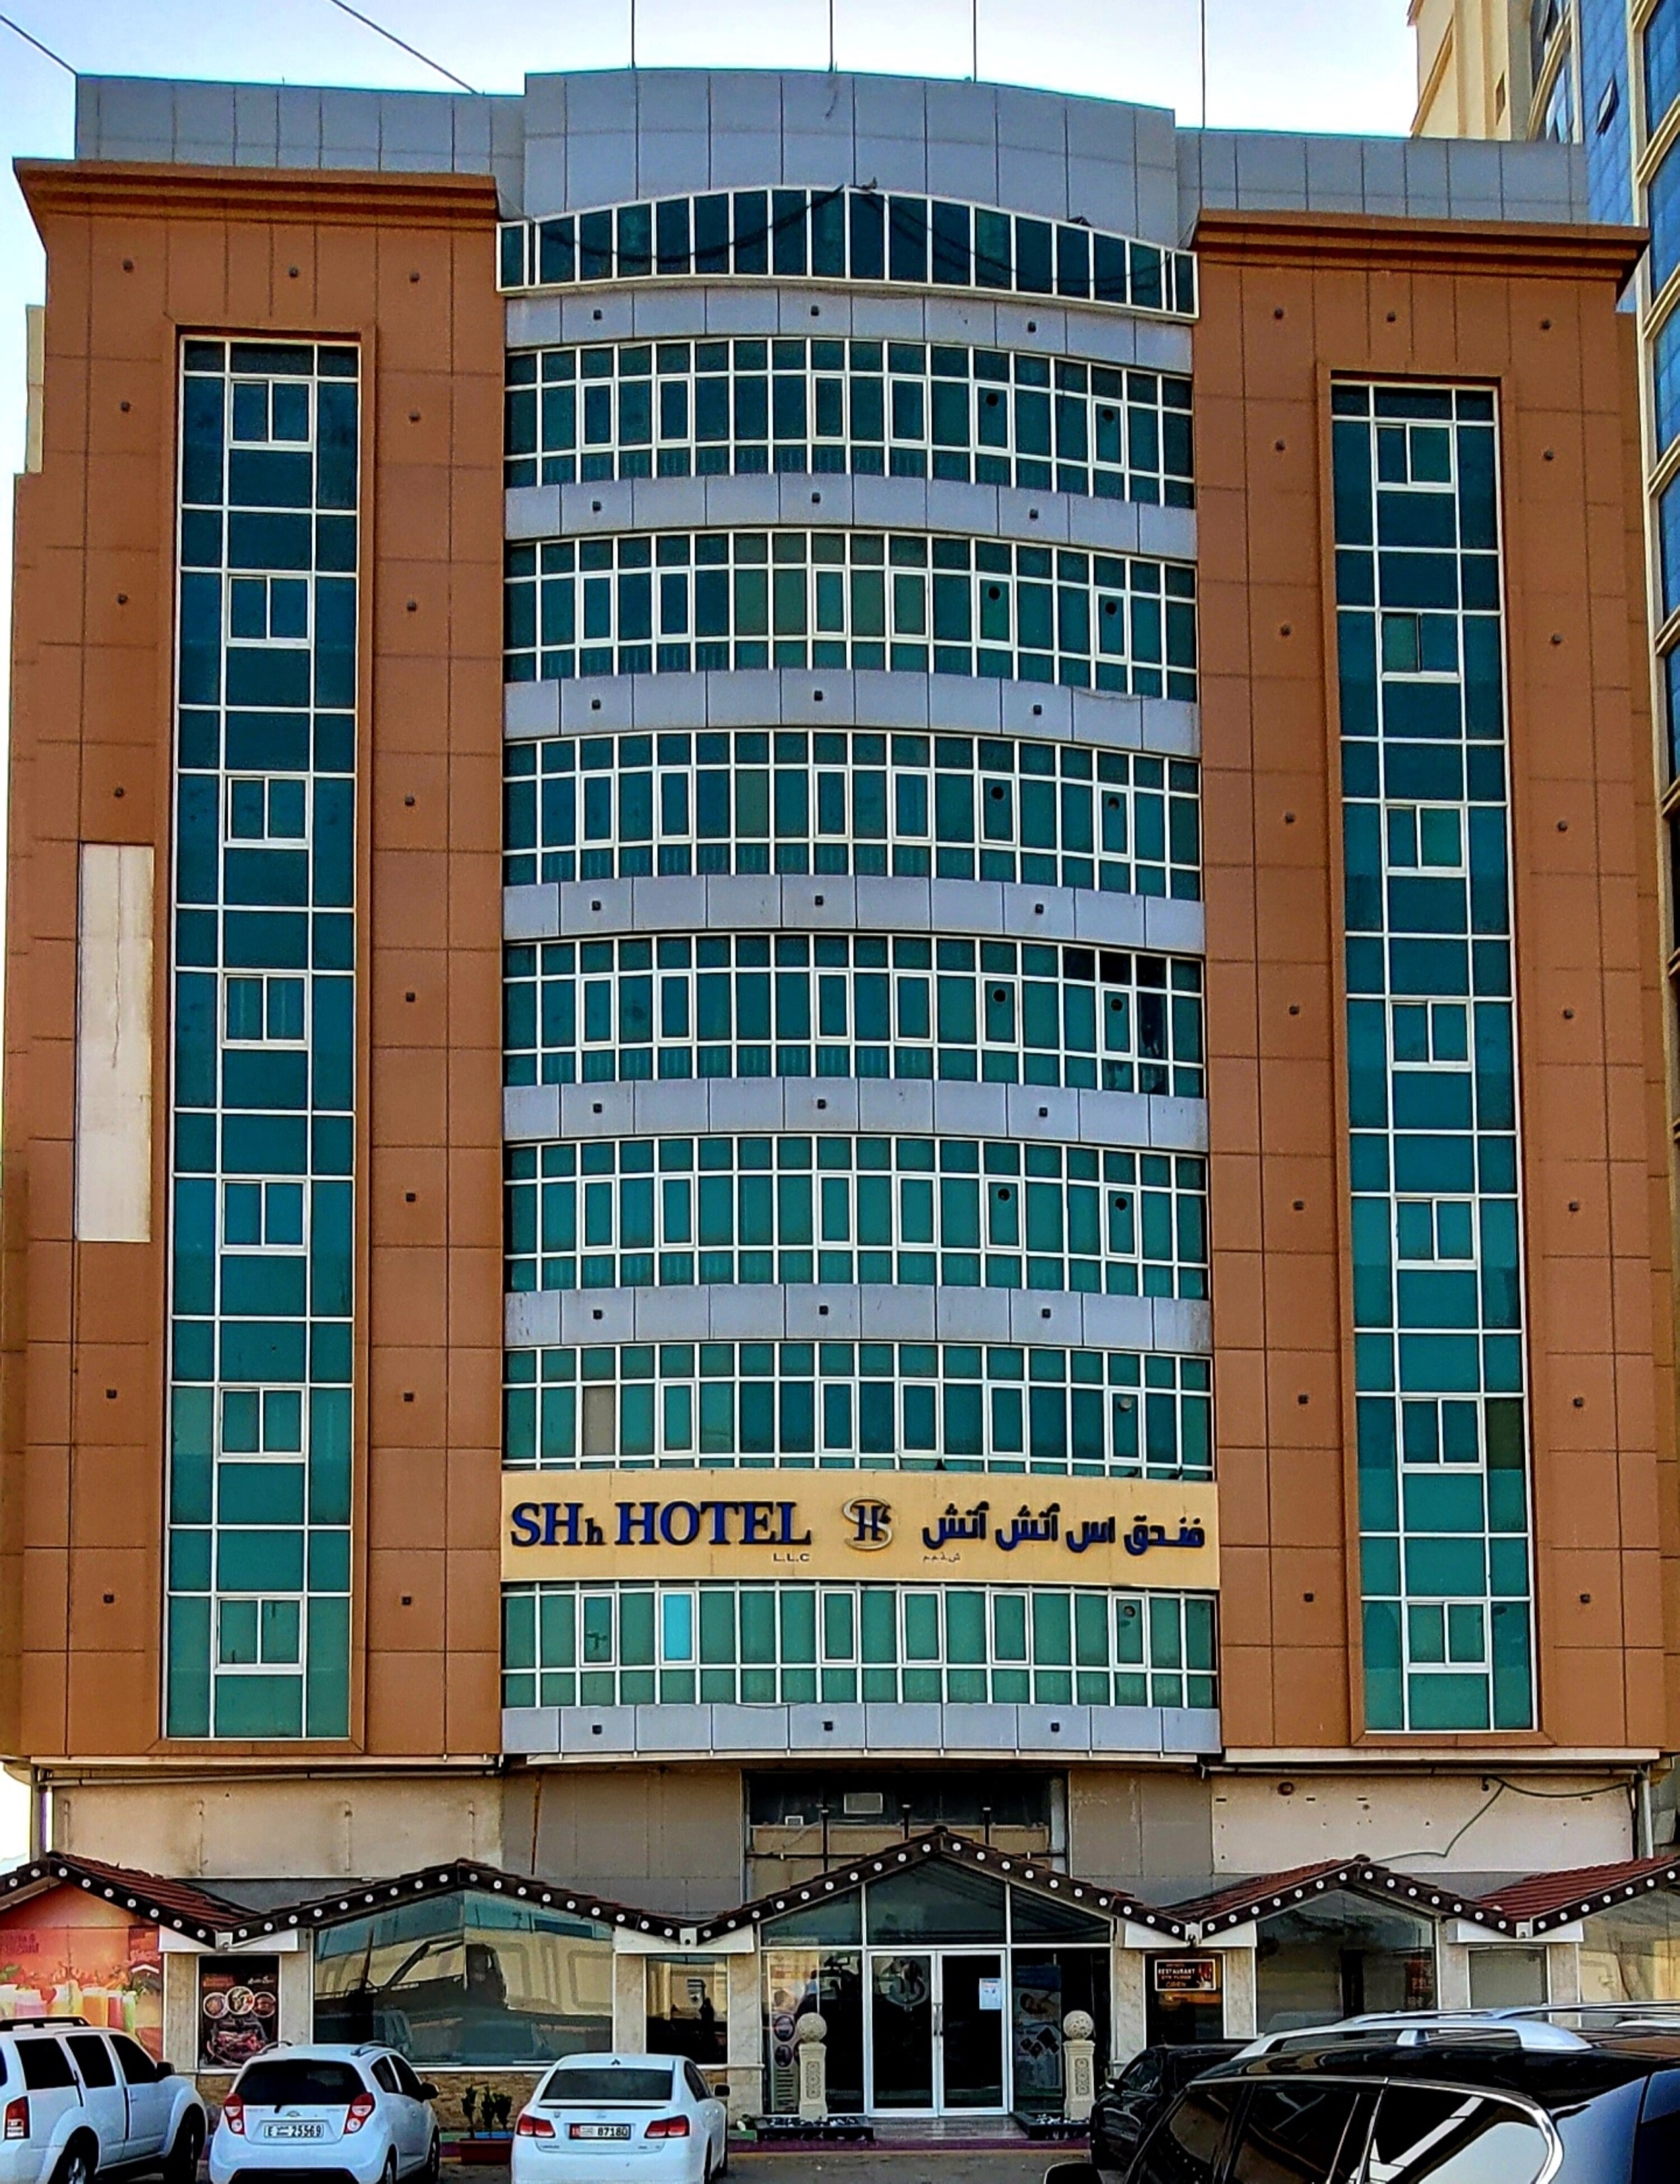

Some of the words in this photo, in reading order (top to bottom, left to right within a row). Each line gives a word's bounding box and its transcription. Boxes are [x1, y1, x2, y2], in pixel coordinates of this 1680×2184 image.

[614, 1501, 812, 1546] HOTEL
[1065, 1516, 1116, 1553] اس
[1123, 1514, 1205, 1556] فندق
[773, 1552, 810, 1562] L.L.C
